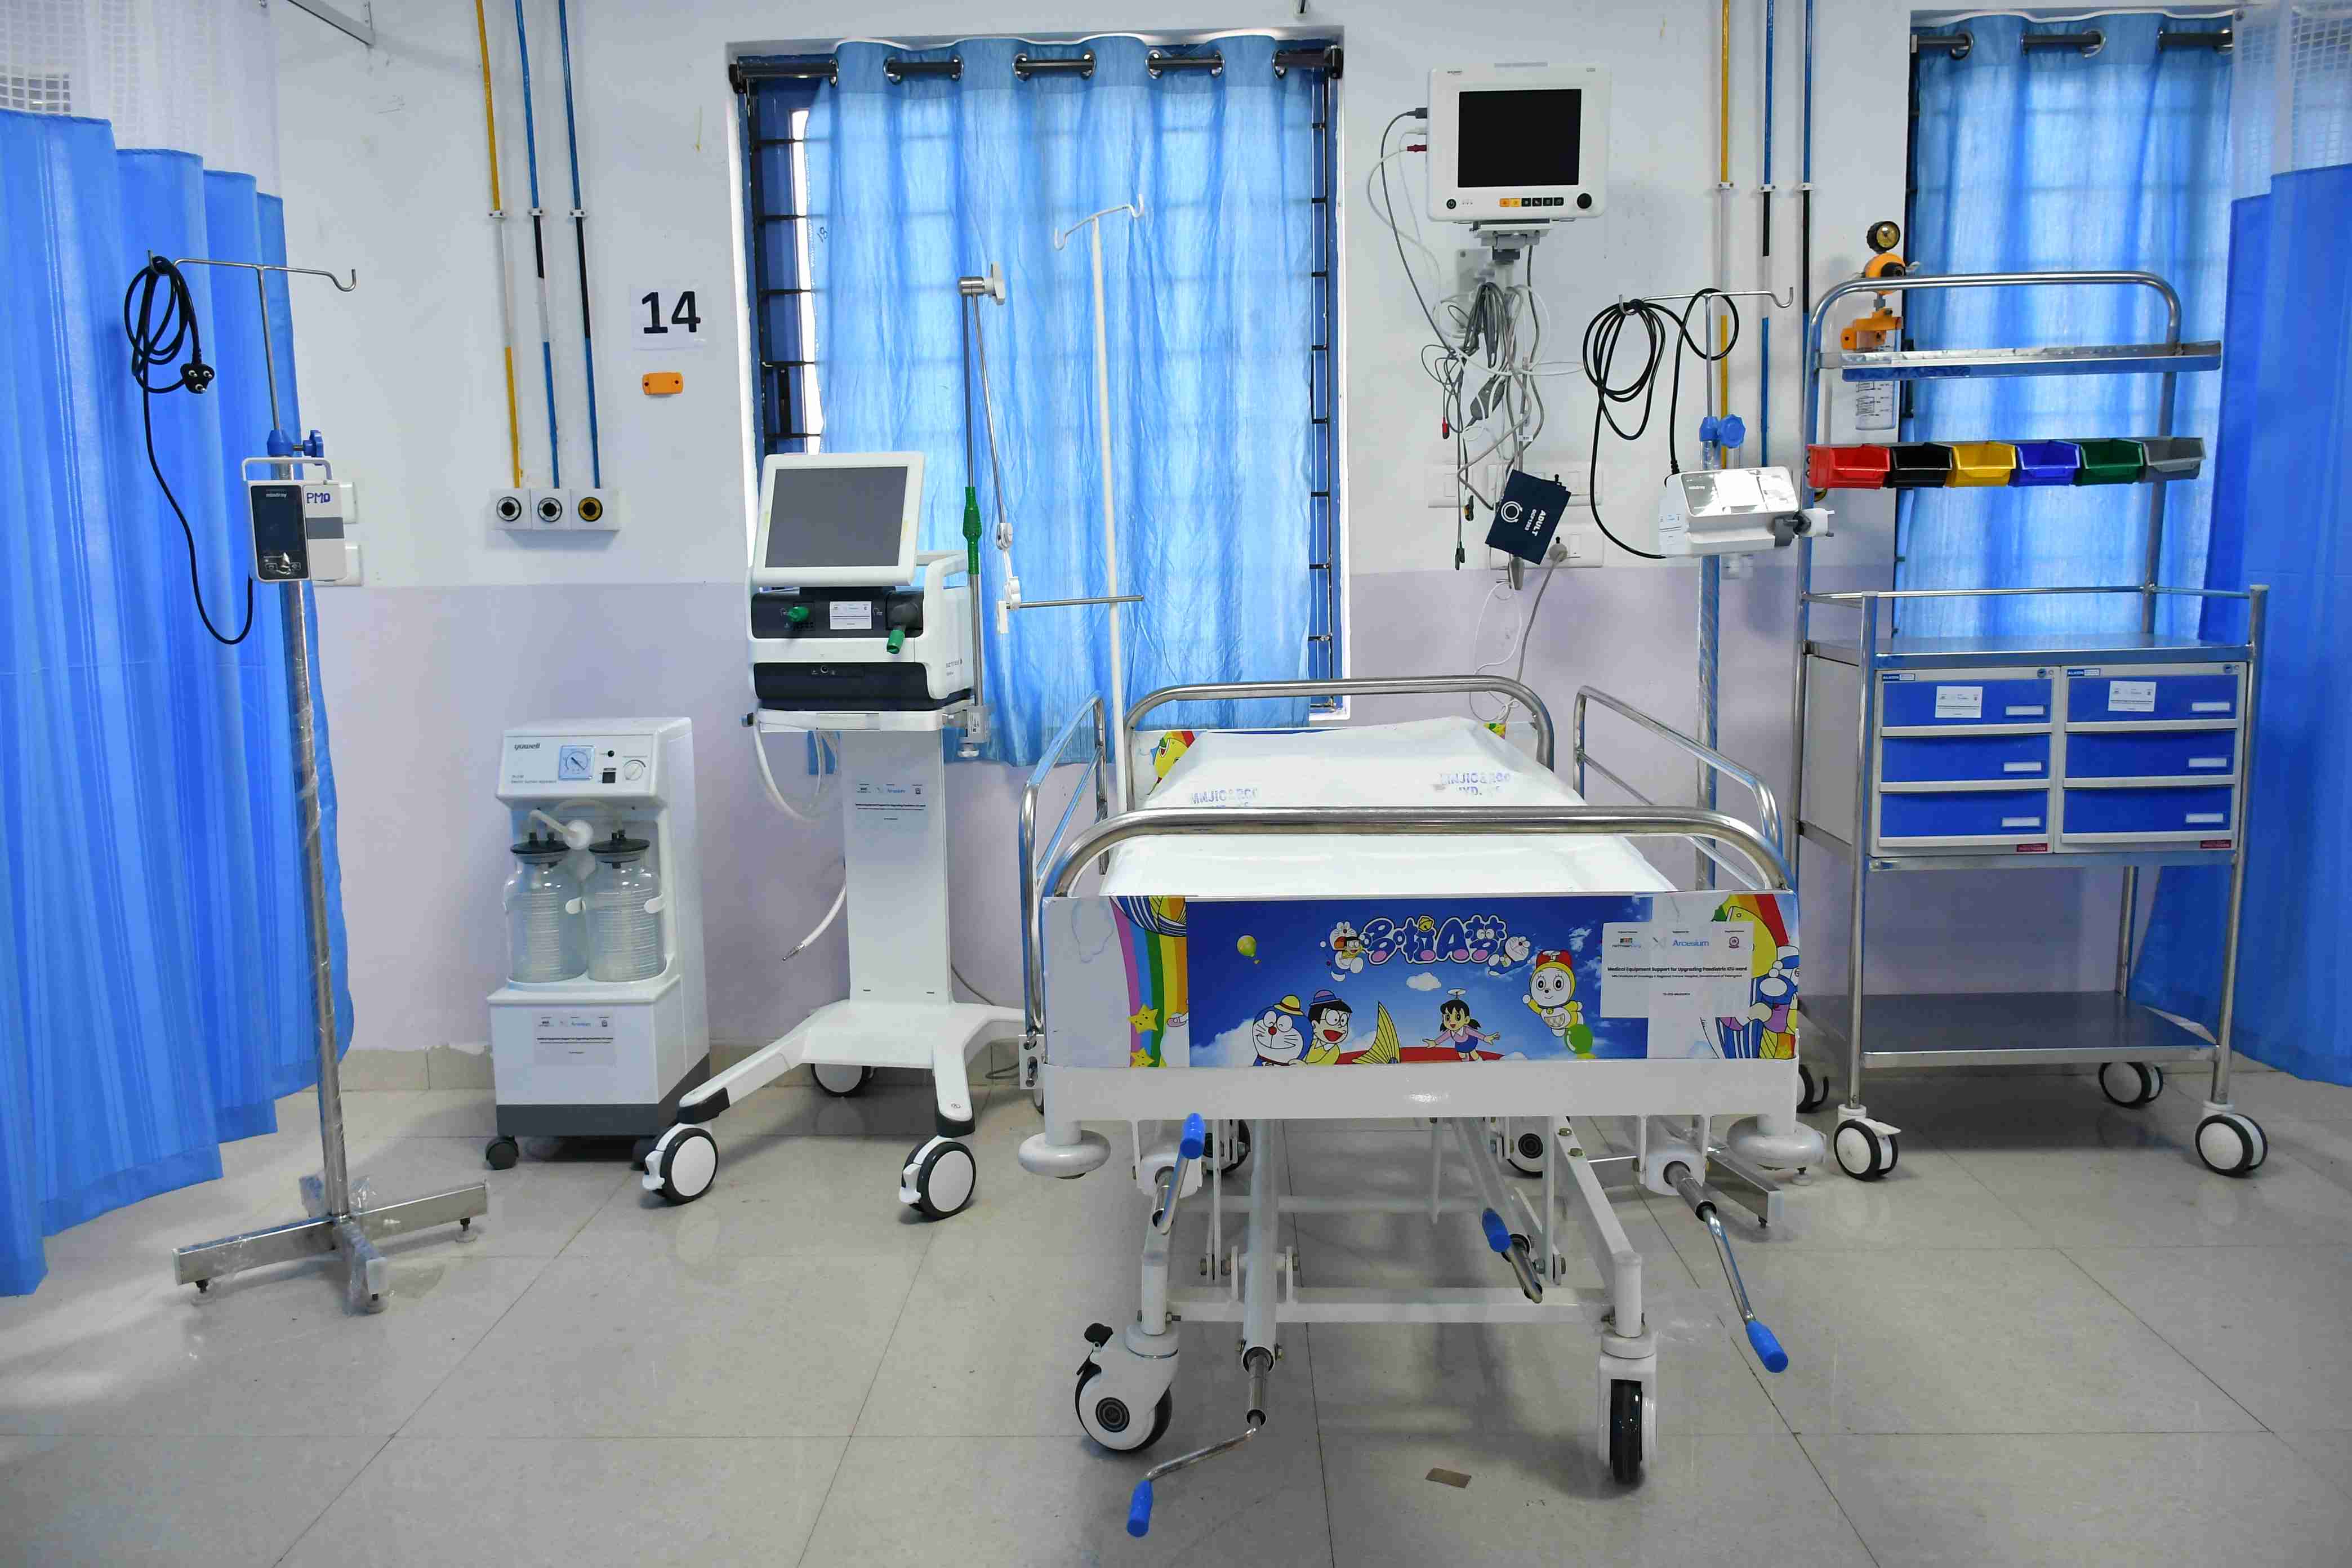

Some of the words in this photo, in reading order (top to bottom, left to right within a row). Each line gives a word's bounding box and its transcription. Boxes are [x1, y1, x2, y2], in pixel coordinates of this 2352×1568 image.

[641, 291, 701, 334] 14
[1531, 510, 1546, 537] ADULT
[514, 743, 541, 751] yuwell
[1672, 939, 1709, 947] Arcesium
